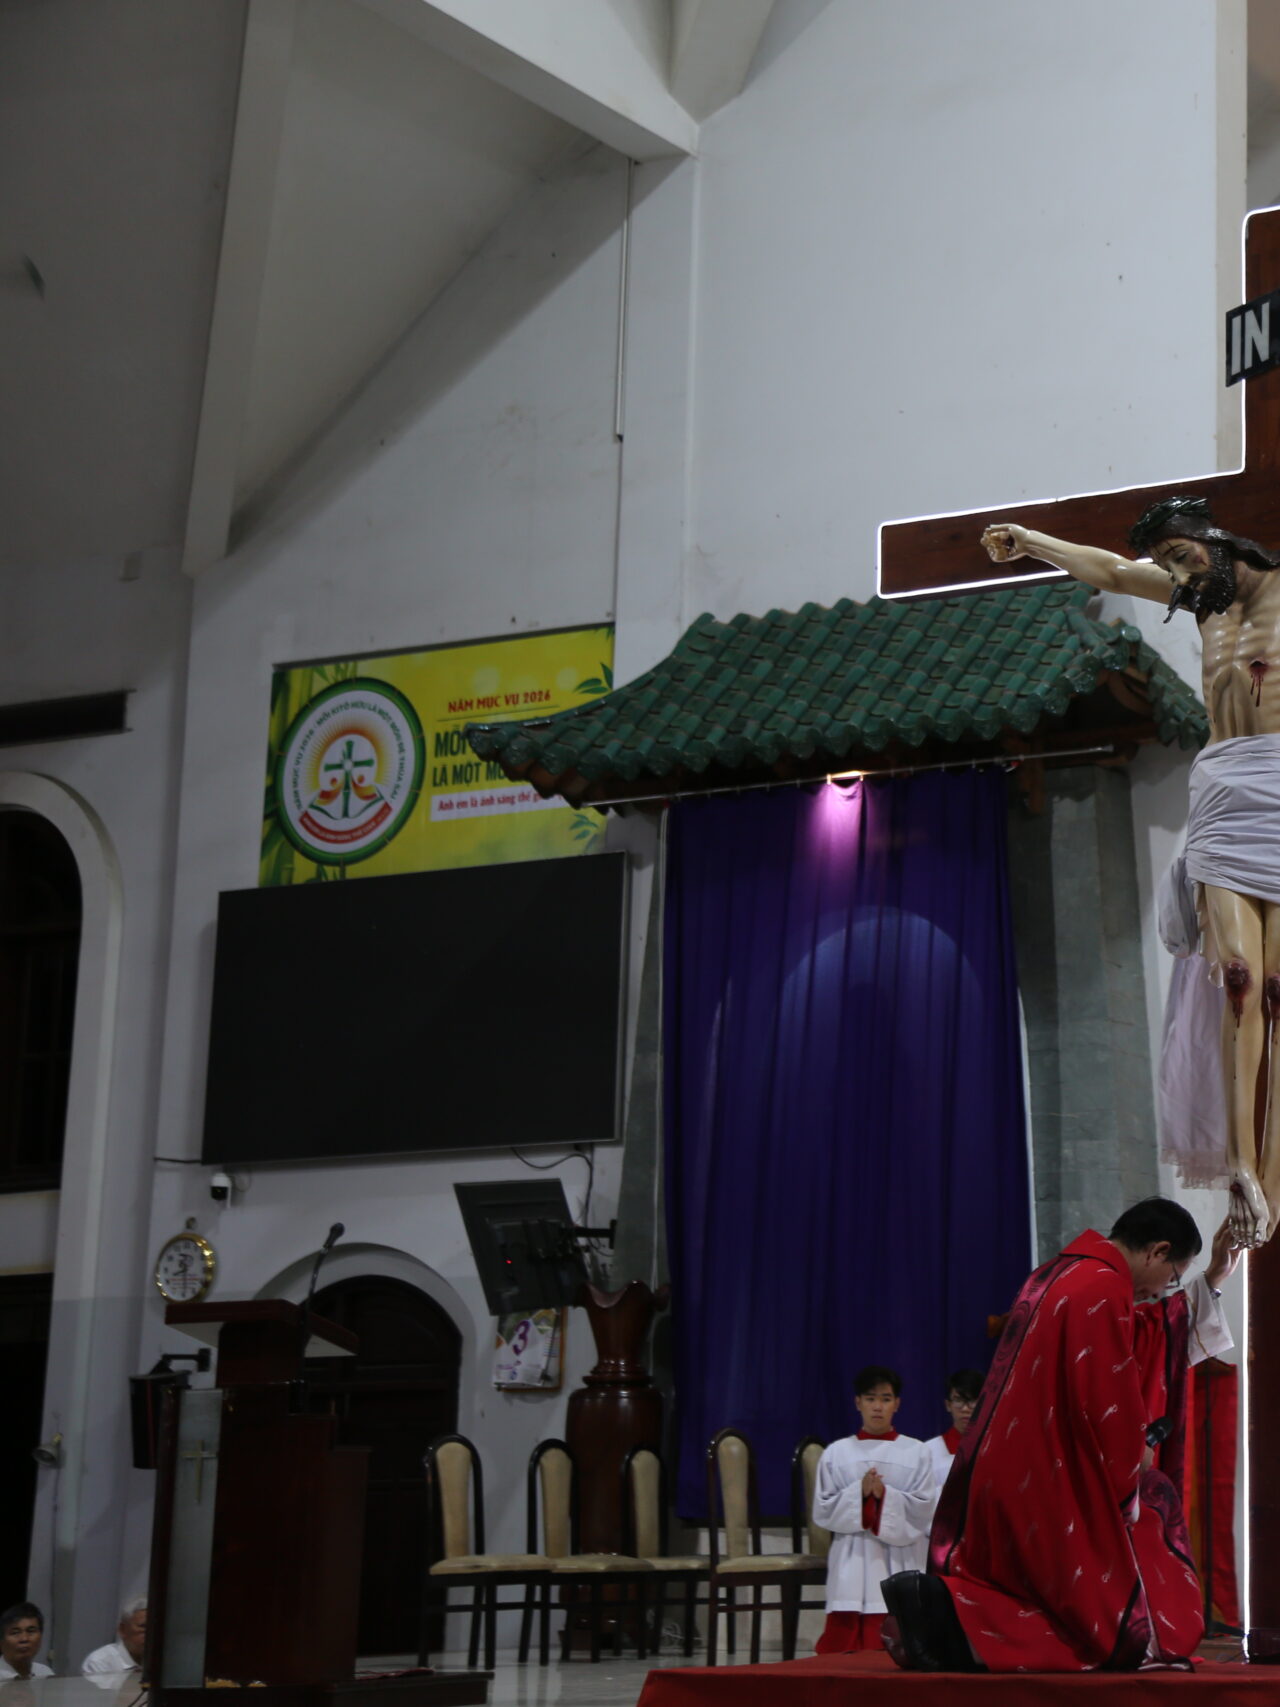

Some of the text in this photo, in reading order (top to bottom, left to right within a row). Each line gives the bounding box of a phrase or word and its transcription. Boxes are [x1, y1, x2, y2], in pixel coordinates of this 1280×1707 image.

[1230, 301, 1270, 376] IN
[448, 690, 551, 713] NĂM MỤC VỤ 2026
[433, 763, 448, 787] LÀ
[453, 760, 482, 788] MỘT
[512, 1320, 531, 1356] 3
